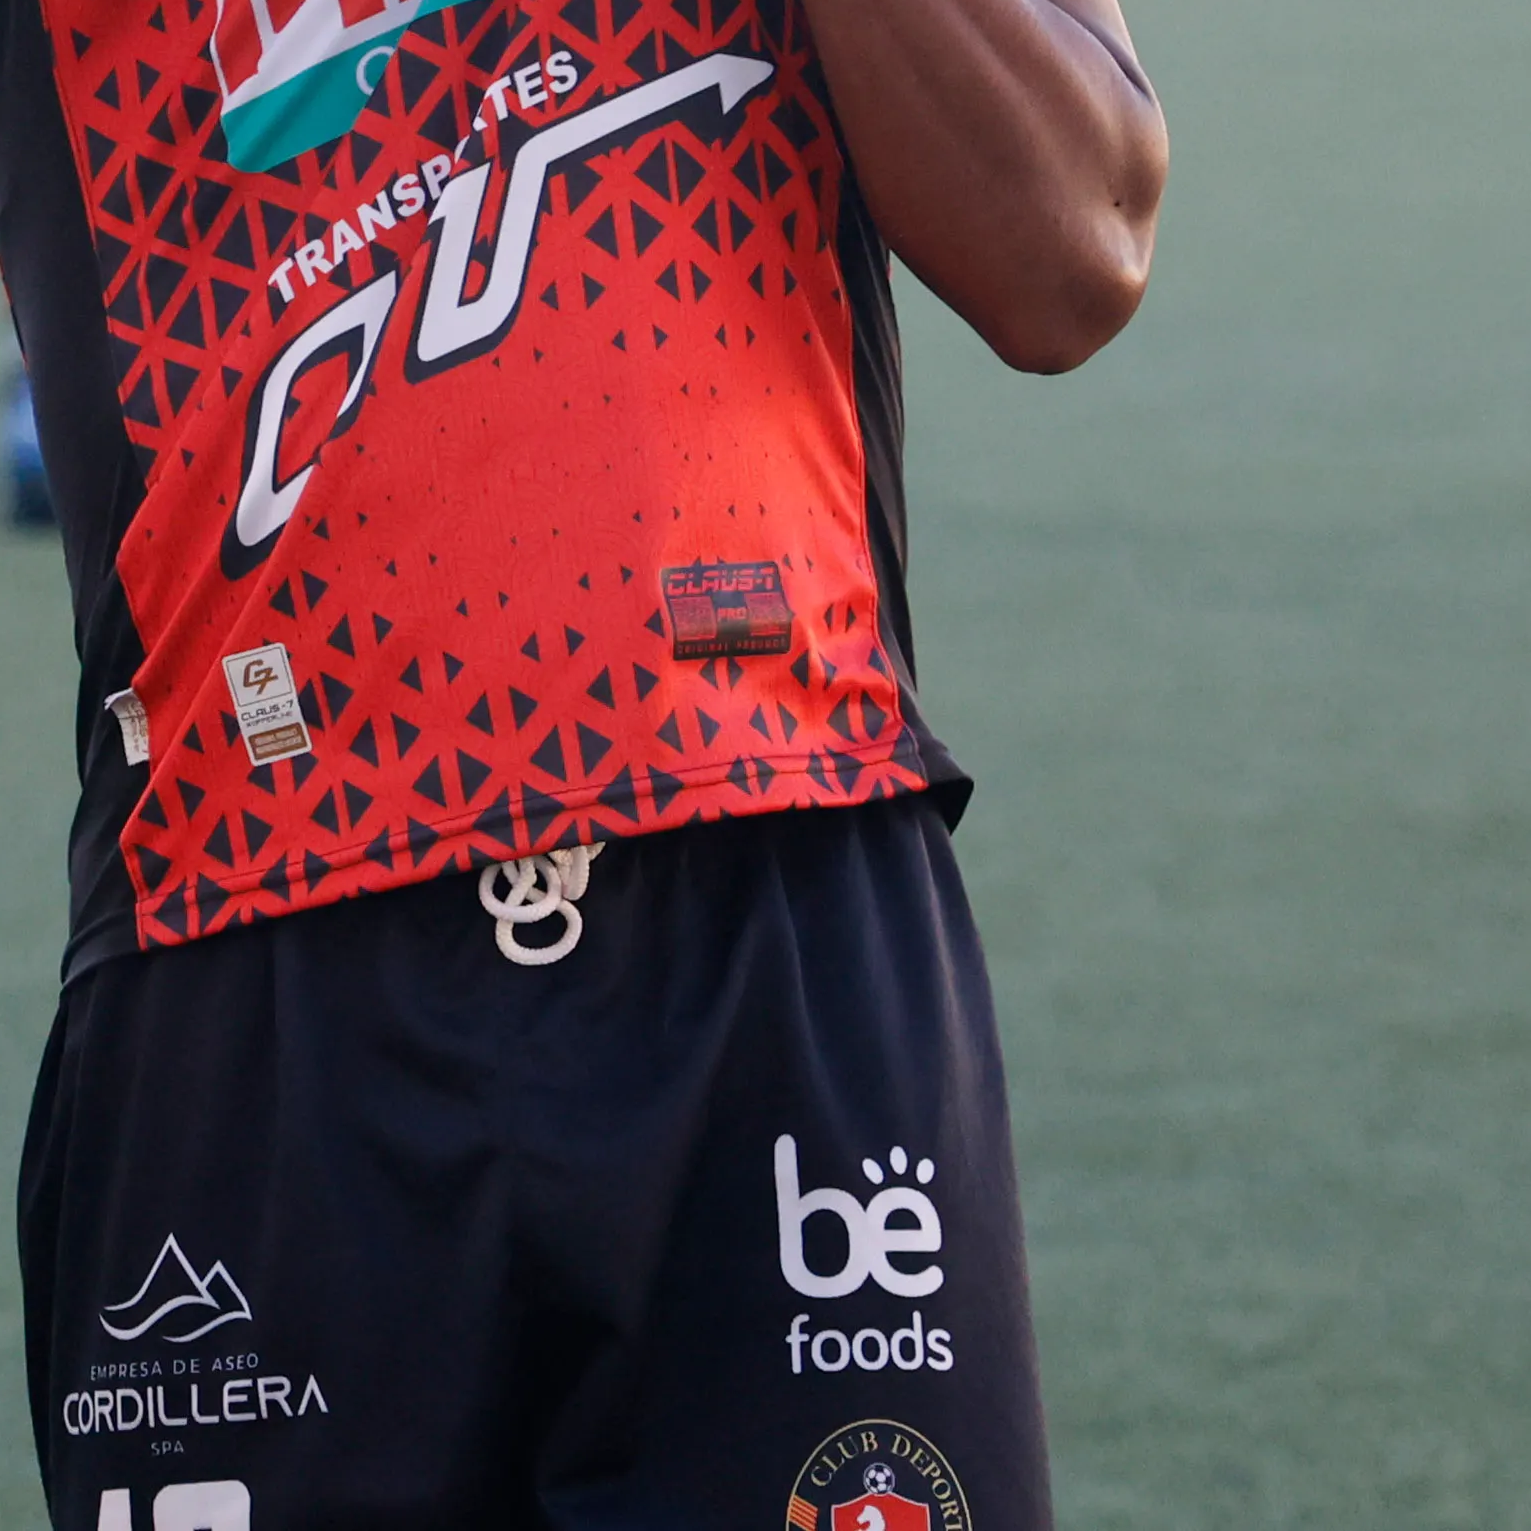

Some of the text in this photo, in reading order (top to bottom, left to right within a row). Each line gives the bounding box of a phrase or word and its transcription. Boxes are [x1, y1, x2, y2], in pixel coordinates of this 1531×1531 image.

[268, 50, 578, 303] TRANSPTES
[773, 1133, 945, 1299] be
[90, 1352, 260, 1382] EMPRESA DE ASEO
[785, 1310, 955, 1375] foods
[62, 1373, 330, 1436] CORDILLERA
[150, 1439, 185, 1457] SPA
[810, 1430, 880, 1487] CLUB
